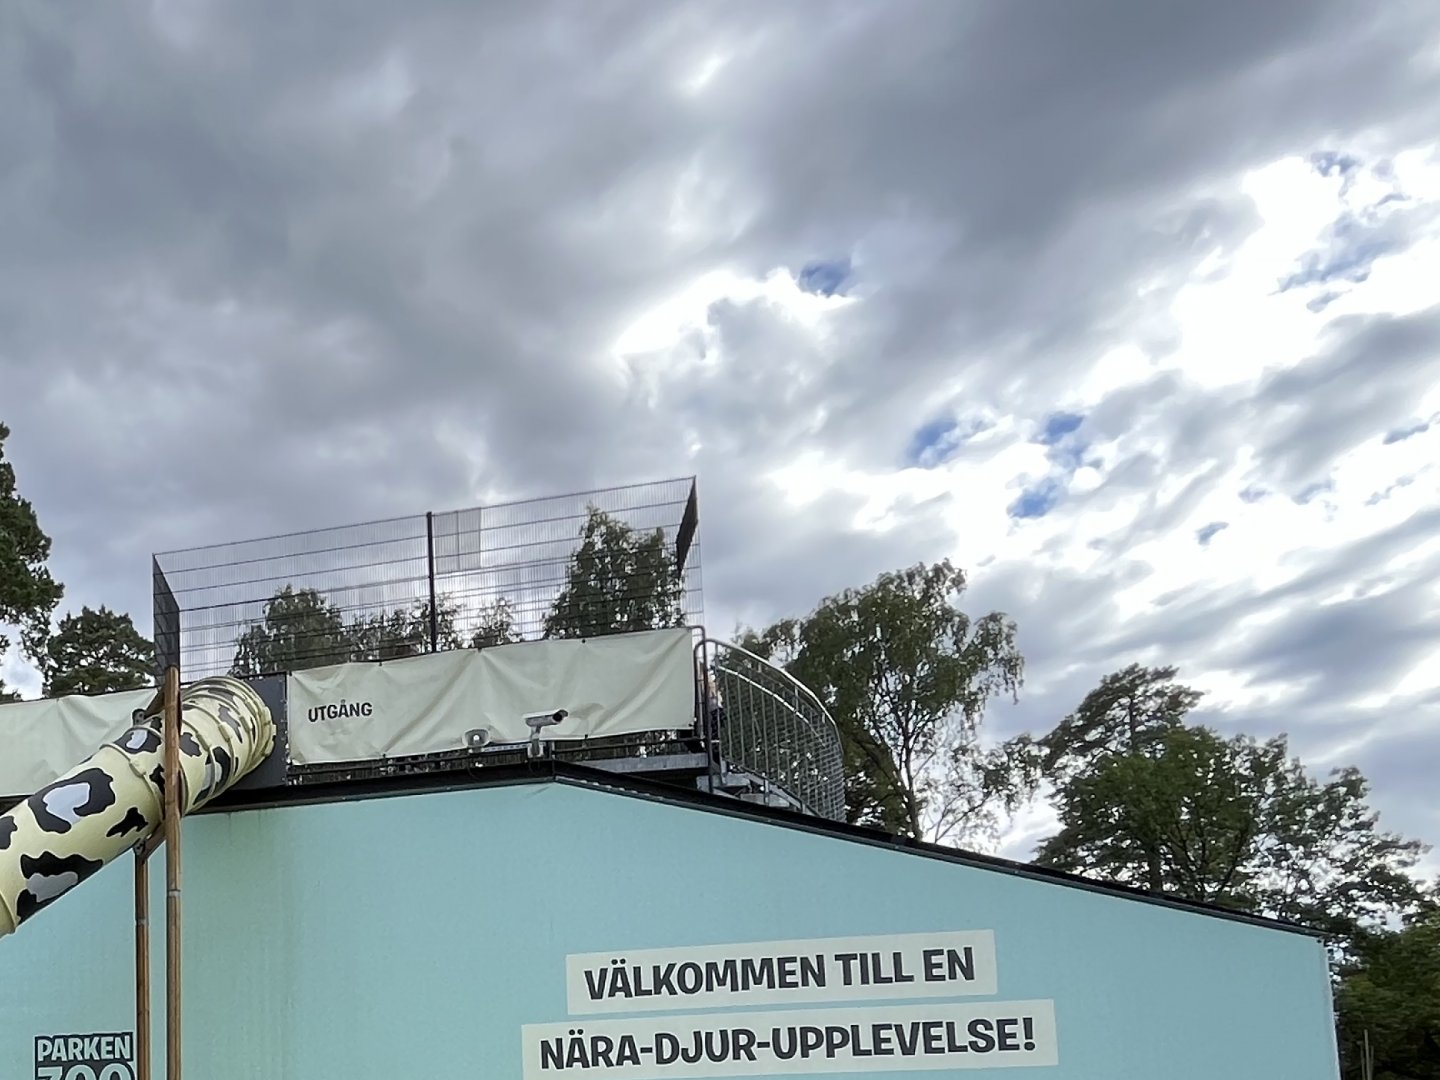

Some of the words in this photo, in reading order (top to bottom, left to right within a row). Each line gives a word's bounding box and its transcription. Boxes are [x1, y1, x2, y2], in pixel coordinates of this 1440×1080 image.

[308, 699, 372, 722] UTGÅNG
[584, 954, 826, 1000] VÄLKOMMEN
[834, 951, 915, 986] TILL
[922, 946, 975, 982] EN
[36, 1034, 132, 1062] PARKEN
[540, 1017, 1036, 1070] NÄRA-DJUR-UPPLEVELSE!
